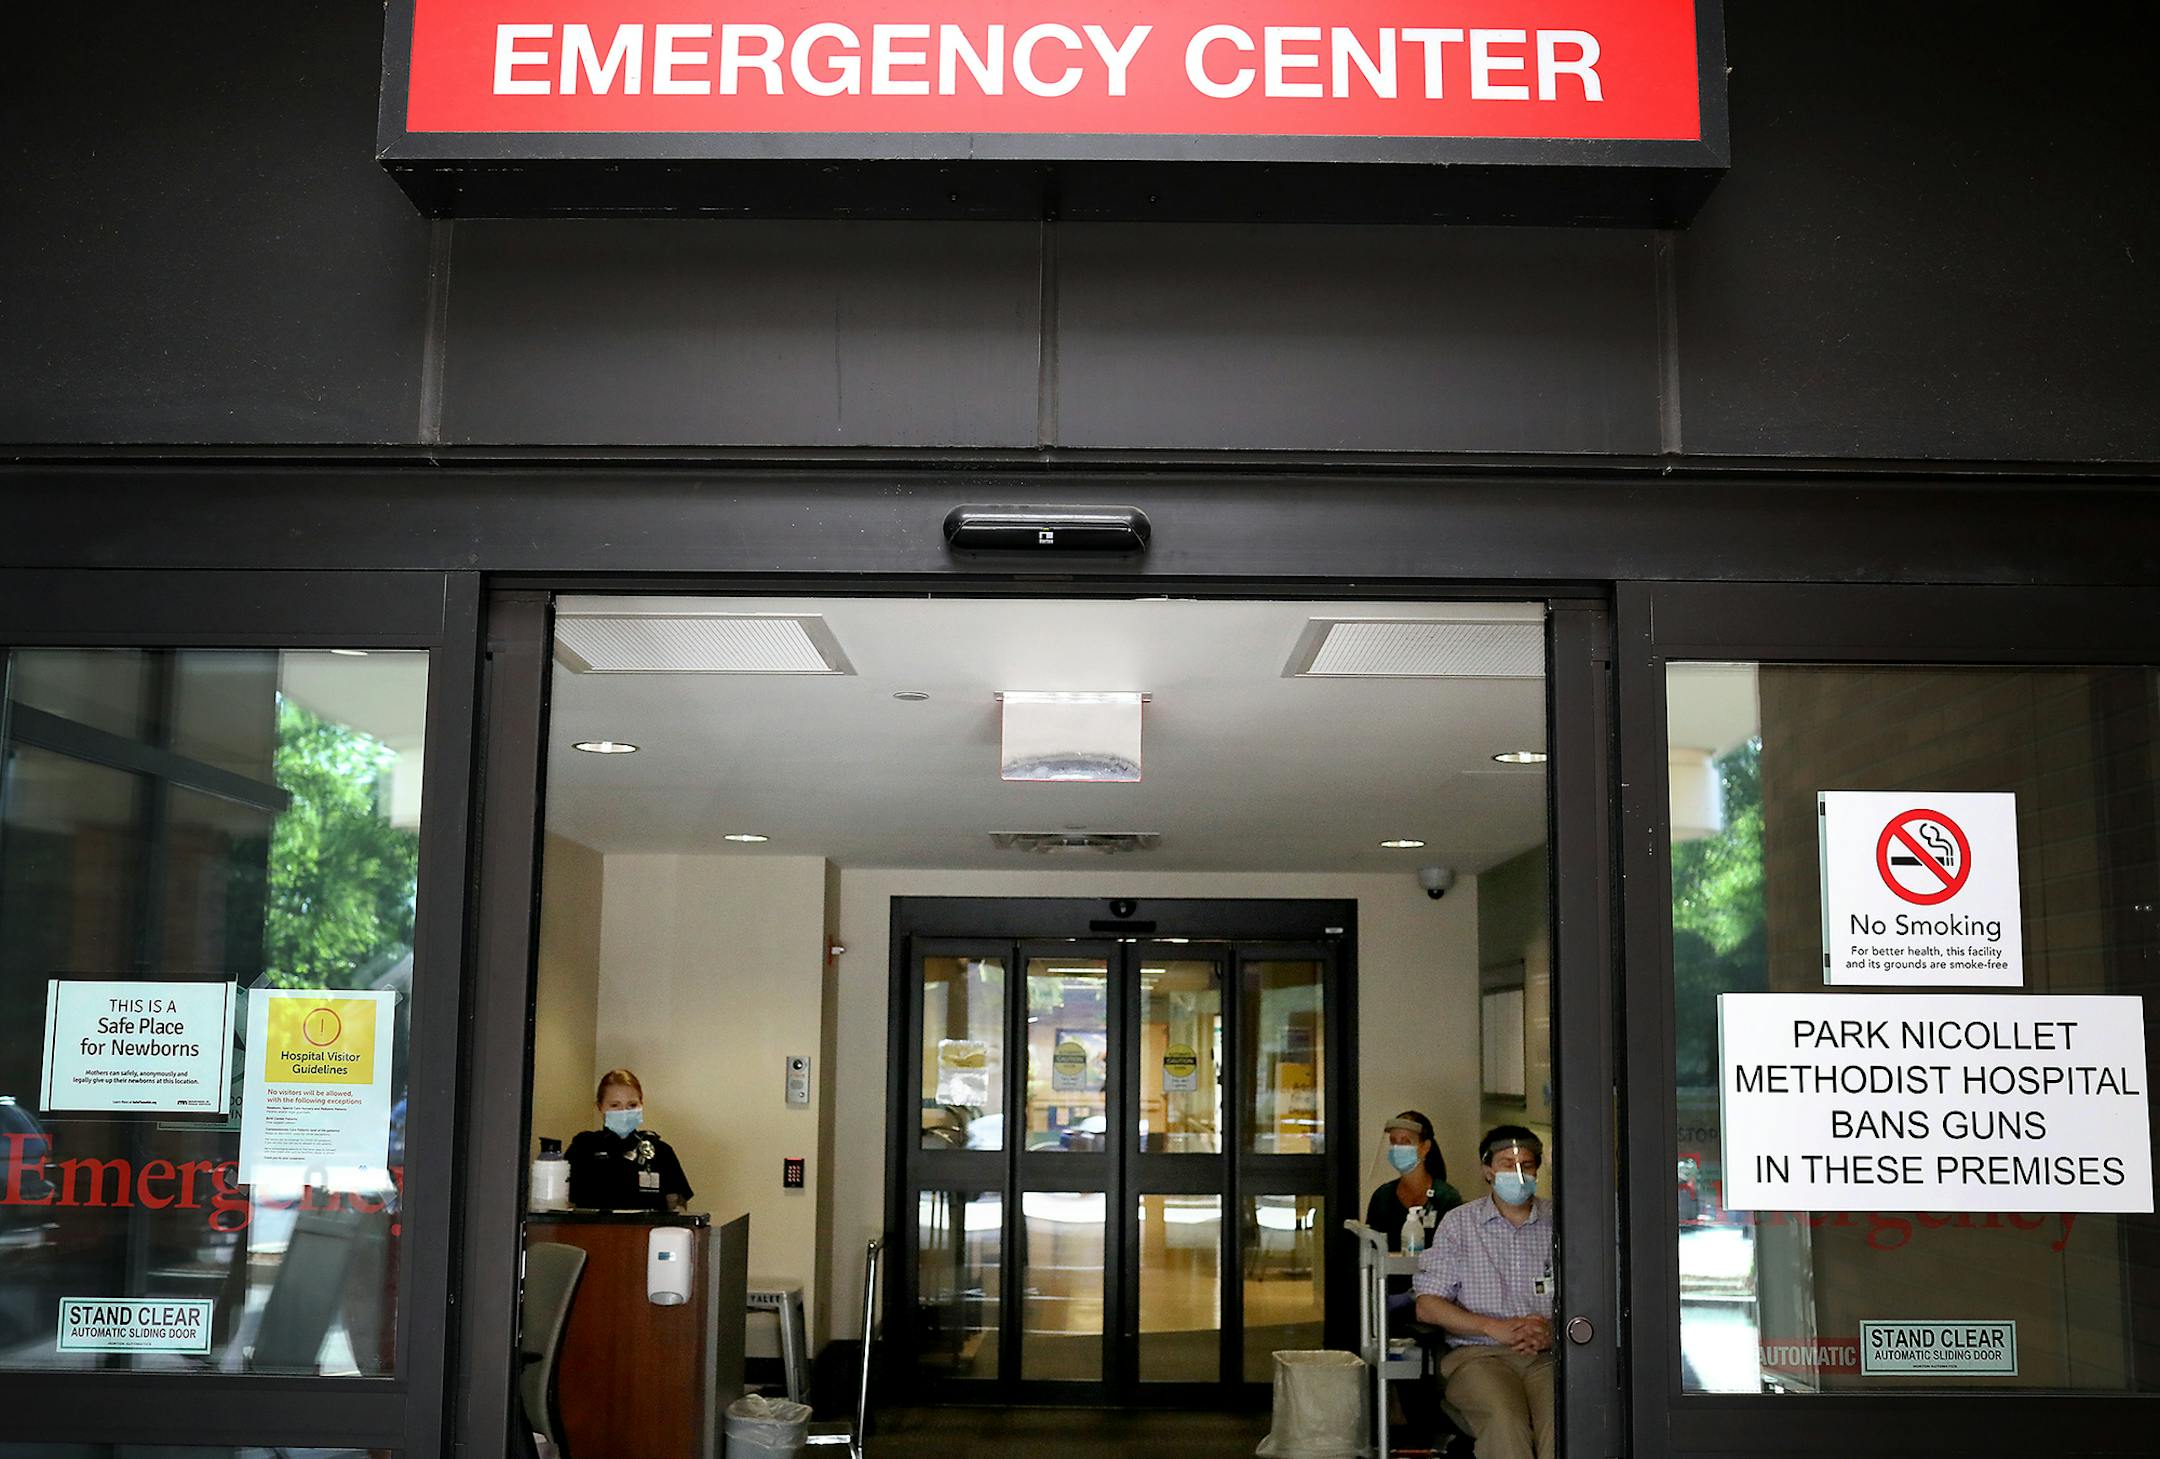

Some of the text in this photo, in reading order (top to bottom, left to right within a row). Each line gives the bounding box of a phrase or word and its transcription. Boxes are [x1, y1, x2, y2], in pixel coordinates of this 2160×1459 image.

[494, 23, 1603, 101] EMERGENCY CENTER
[1851, 914, 2000, 942] No Smoking
[1852, 946, 2002, 961] For better health, this facility
[1846, 959, 1865, 968] and
[1869, 959, 1880, 969] its
[1884, 959, 1926, 971] grounds
[1950, 957, 2008, 969] smoke-free
[110, 999, 176, 1013] THIS IS A
[98, 1017, 183, 1034] Safe Place
[1794, 1021, 2077, 1049] PARK NICOLLET
[81, 1038, 199, 1056] for Newborns
[281, 1051, 360, 1062] Hospital Visitor
[121, 1070, 139, 1078] safely,
[139, 1071, 176, 1079] anonymously
[293, 1064, 347, 1074] Guidelines
[73, 1077, 92, 1085] legally
[92, 1077, 104, 1085] give
[1737, 1065, 2139, 1095] METHODIST HOSPITAL
[295, 1097, 326, 1105] following
[327, 1098, 362, 1106] exceptions
[1832, 1110, 2046, 1139] BANS GUNS
[1757, 1156, 2124, 1185] IN THESE PREMISES
[2, 1133, 404, 1238] Emerg
[70, 1306, 200, 1326] STAND CLEAR
[71, 1328, 196, 1338] AUTOMATIC SLIDING DOOR
[1872, 1329, 2005, 1348] STAND CLEAR
[1759, 1346, 1857, 1367] AUTOMATIC
[1875, 1350, 2002, 1360] AUTOMATIC SLIDING DOOR
